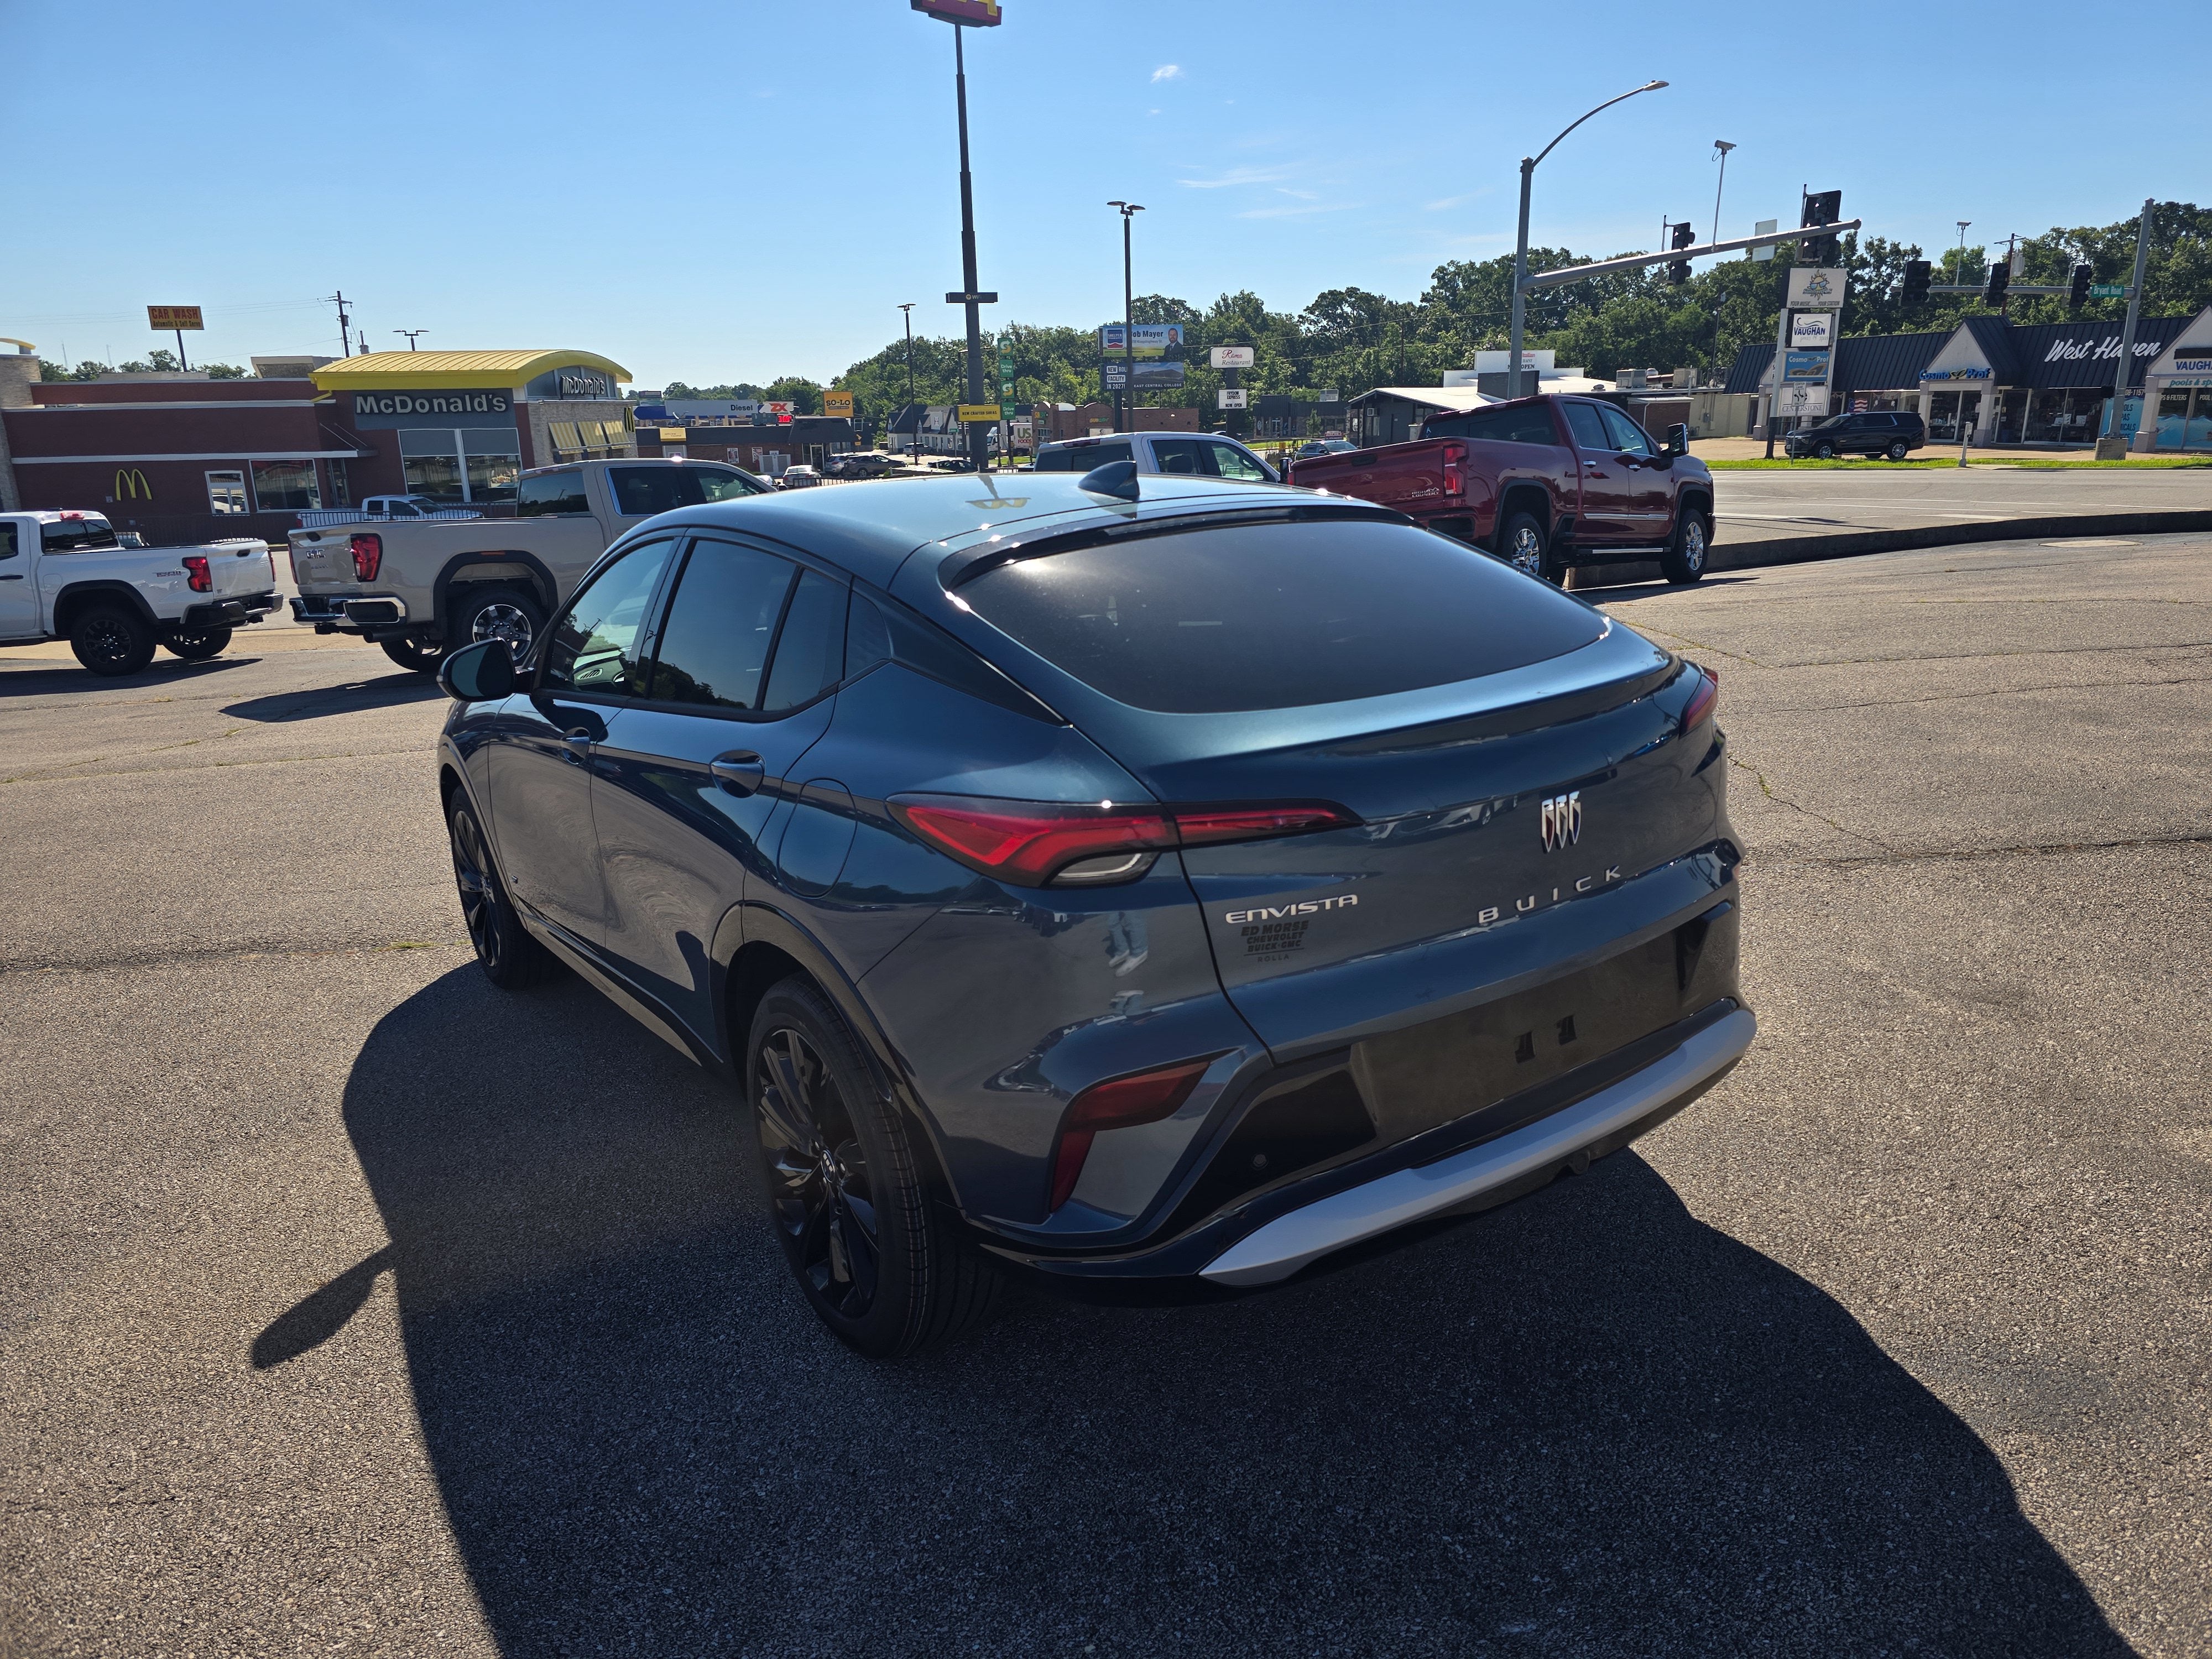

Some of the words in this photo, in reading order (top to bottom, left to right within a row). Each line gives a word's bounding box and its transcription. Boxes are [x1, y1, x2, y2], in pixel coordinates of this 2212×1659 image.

[2094, 285, 2109, 296] Bryant
[2110, 286, 2122, 295] Road
[152, 308, 170, 319] CAR
[173, 308, 199, 319] WASH
[1142, 331, 1164, 339] Mayer
[1794, 327, 1826, 336] VAUGHAN
[2044, 338, 2095, 362] West
[2176, 361, 2212, 371] VAUGH
[1919, 369, 1951, 380] Cosmo
[1966, 368, 1991, 379] Prof
[562, 375, 605, 395] McDonald's
[2169, 378, 2193, 388] pools
[356, 395, 507, 414] McDonald's
[1478, 865, 1621, 924] BUICK
[1225, 894, 1358, 924] ENVISTA
[1241, 926, 1260, 937] ED
[1262, 920, 1310, 935] MORSE
[1246, 931, 1305, 945] CHEVROLET
[1257, 954, 1290, 963] ROLLA
